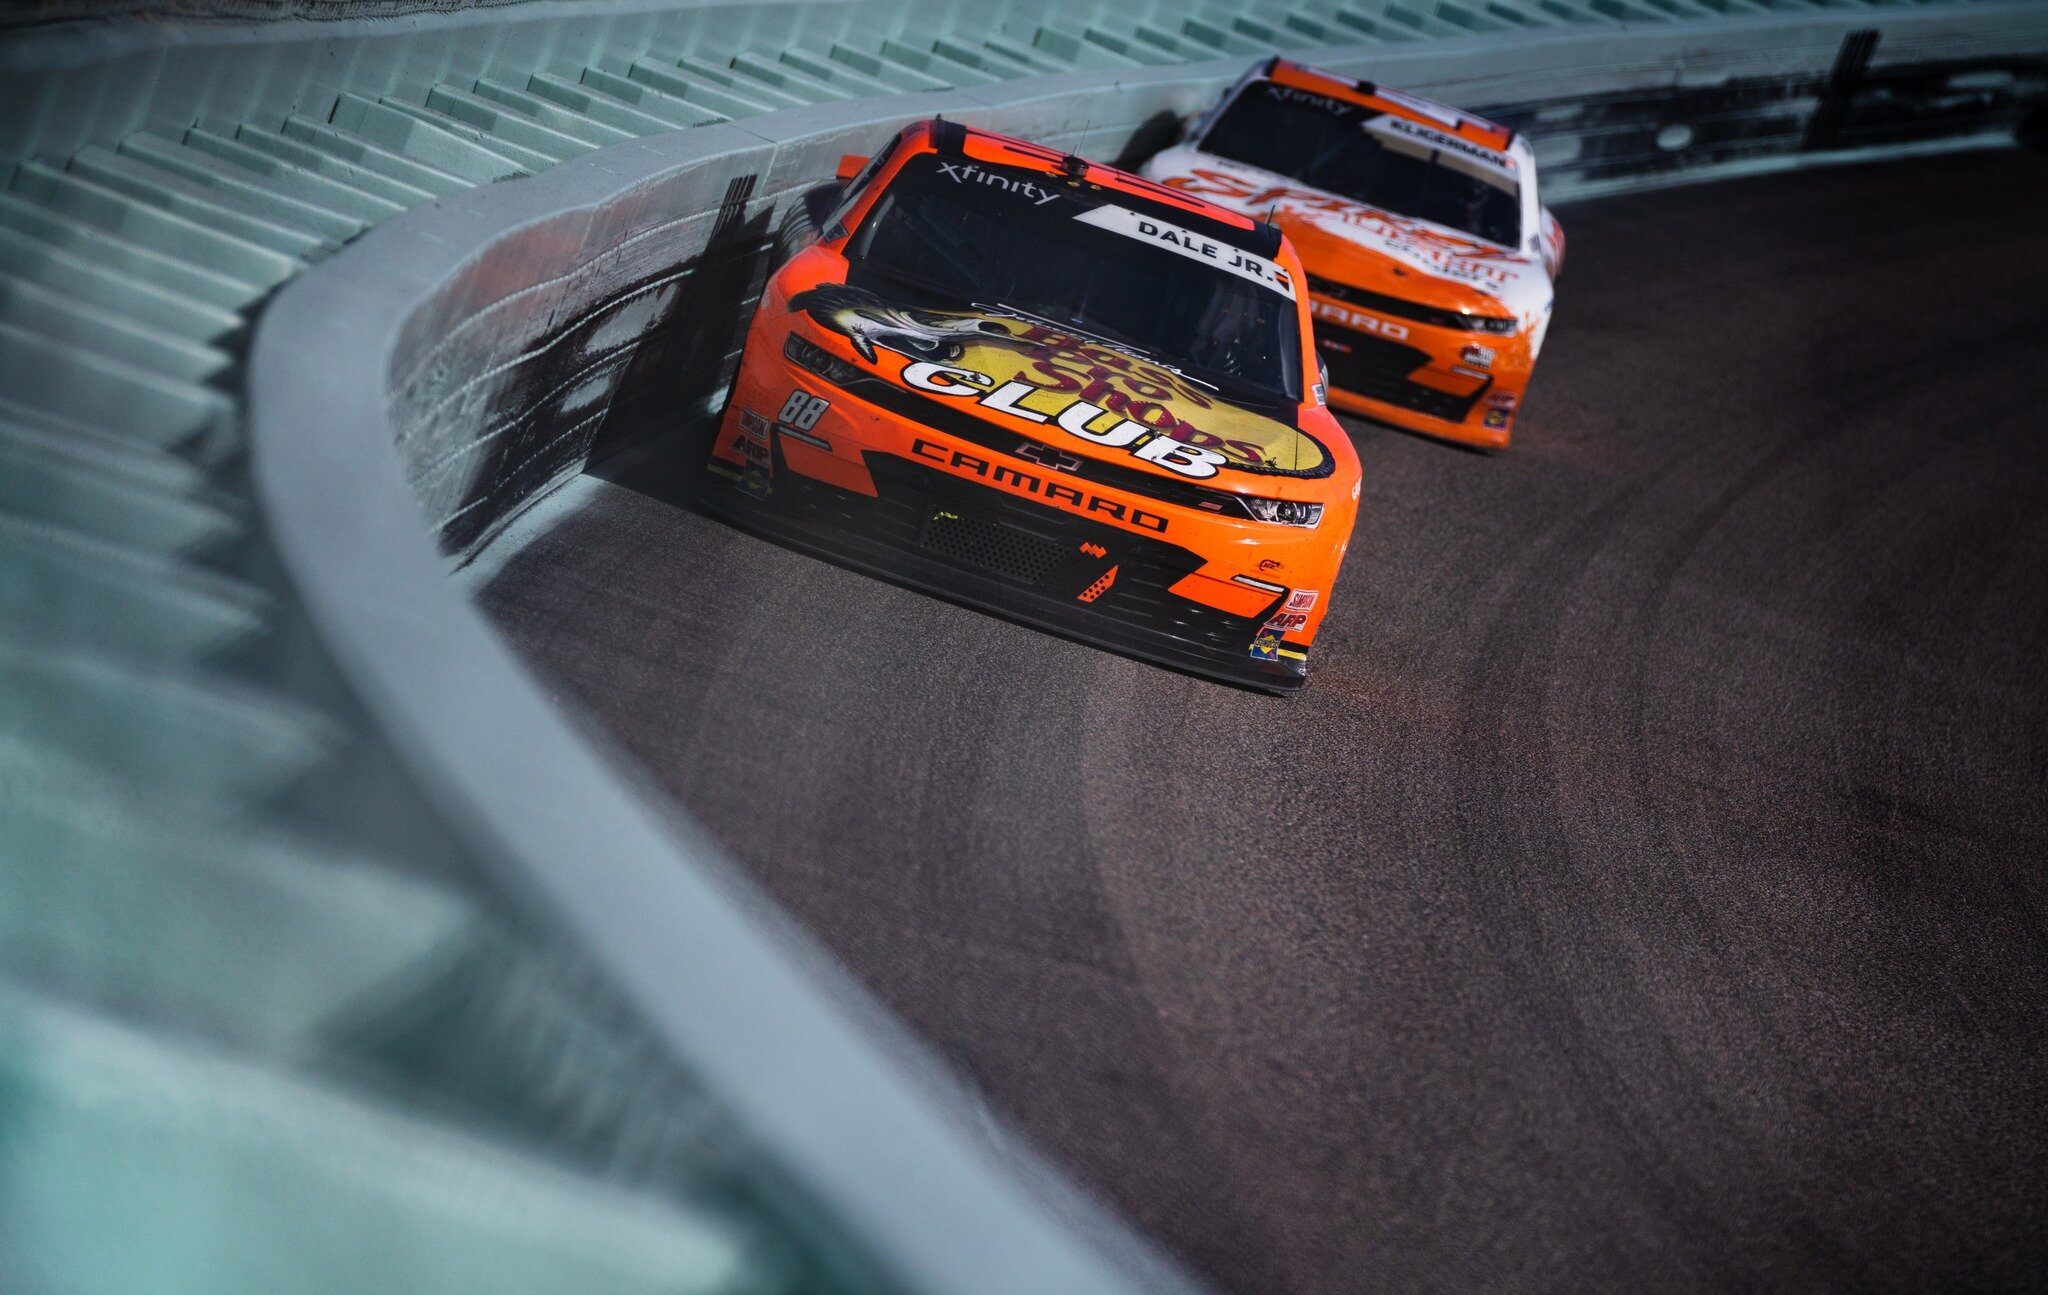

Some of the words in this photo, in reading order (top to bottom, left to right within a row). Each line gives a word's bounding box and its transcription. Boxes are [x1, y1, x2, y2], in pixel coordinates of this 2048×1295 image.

[935, 161, 1061, 205] xfinity
[1137, 220, 1218, 259] DALE
[1227, 253, 1274, 281] JR.
[1013, 324, 1213, 411] Bass
[778, 389, 831, 432] 88
[900, 360, 1229, 479] CLUB
[1012, 359, 1267, 467] Shops
[911, 438, 1169, 533] CAMARO
[1266, 613, 1308, 629] ARP
